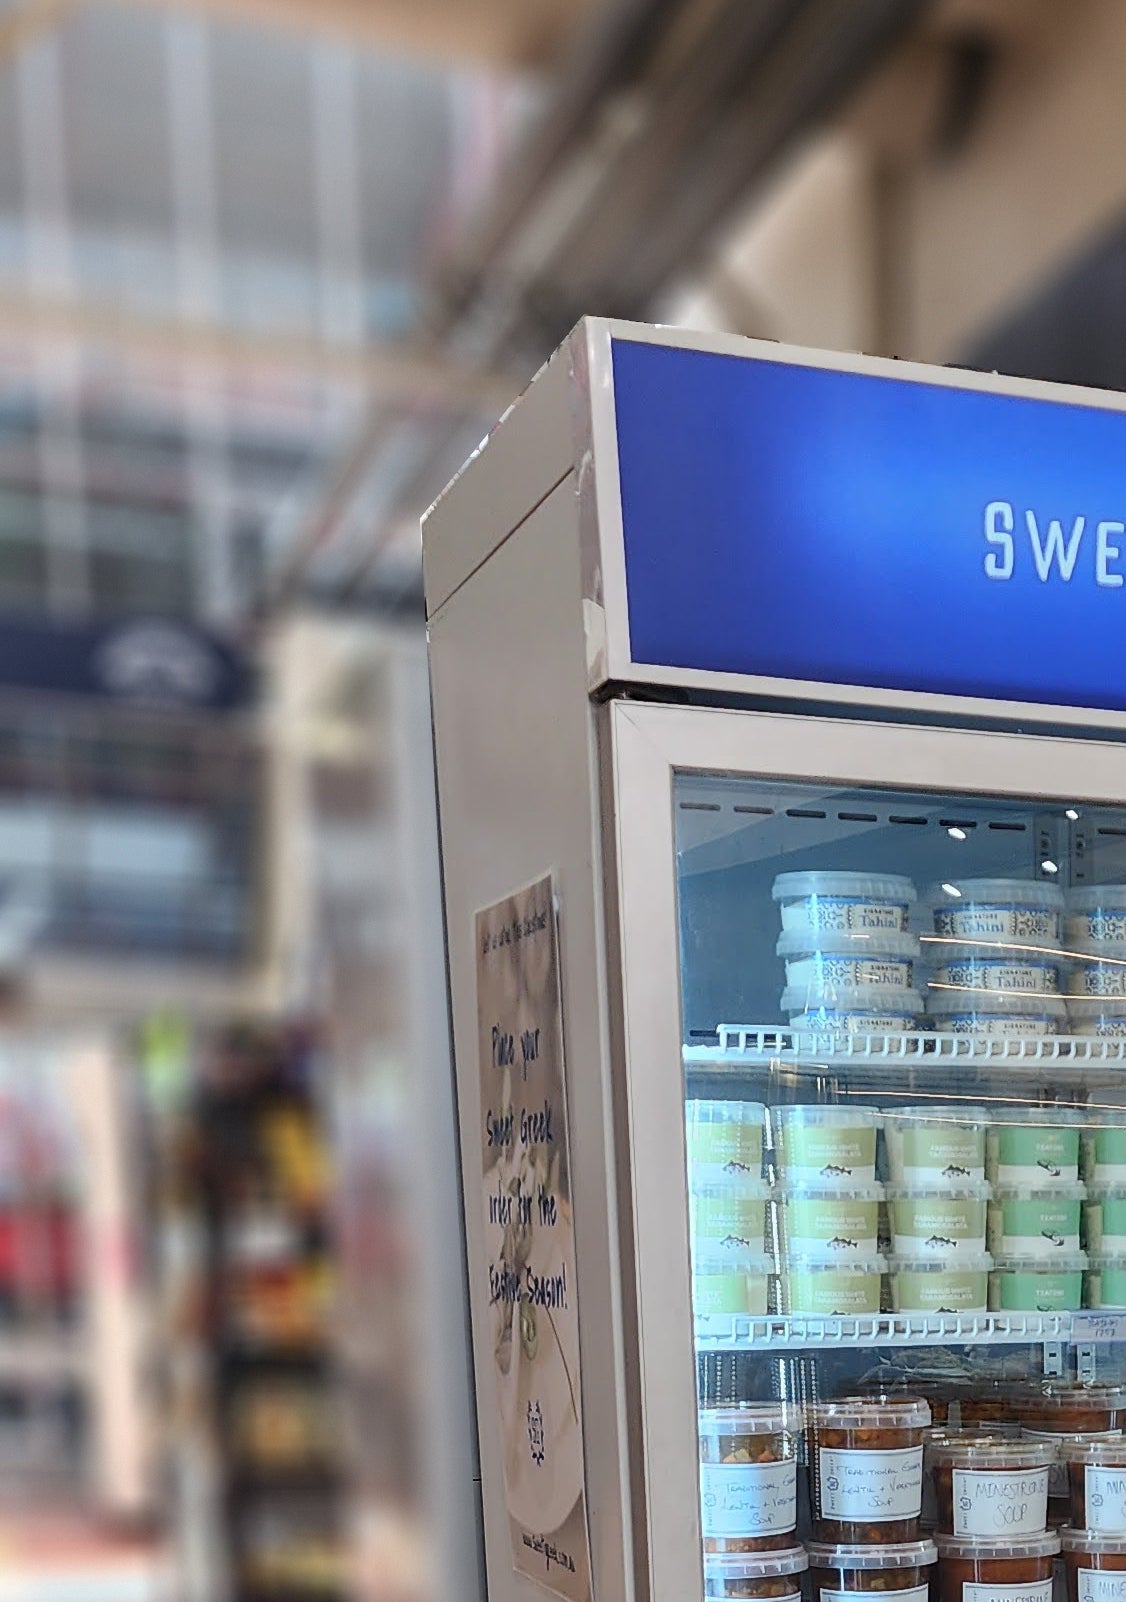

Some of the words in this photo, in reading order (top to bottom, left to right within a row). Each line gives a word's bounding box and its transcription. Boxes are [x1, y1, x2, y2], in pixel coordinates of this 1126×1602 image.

[860, 914, 898, 929] Tahini
[959, 921, 1004, 933] Tahini
[996, 975, 1037, 989] Tahini
[486, 1103, 514, 1147] Sweet
[520, 1099, 553, 1148] Greek
[537, 1184, 557, 1227] the
[526, 1262, 568, 1310] Season!
[992, 1502, 1029, 1528] SOUP
